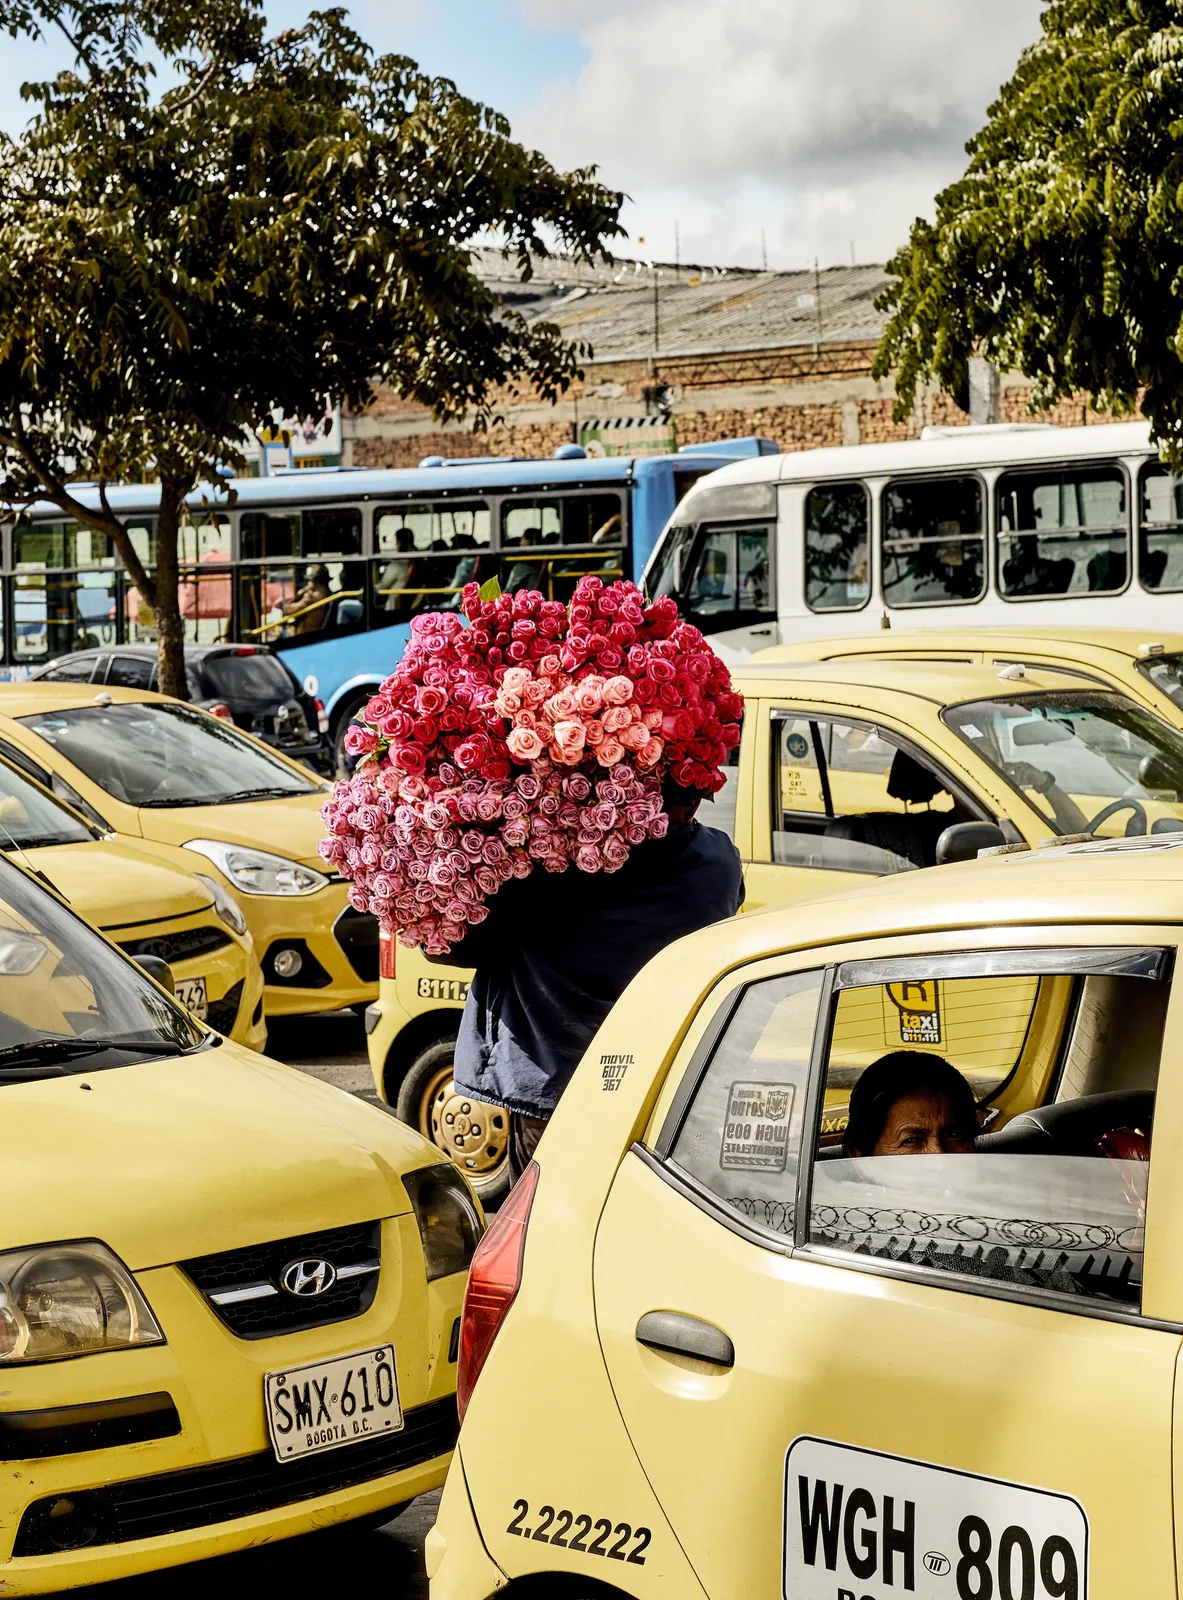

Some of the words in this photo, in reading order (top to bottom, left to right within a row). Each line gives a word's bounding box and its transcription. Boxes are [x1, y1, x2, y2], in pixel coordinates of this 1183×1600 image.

[902, 1012, 938, 1030] taxi
[903, 1032, 939, 1042] 8111.111
[602, 1065, 628, 1078] 6077
[602, 1079, 622, 1091] 367
[274, 1376, 332, 1434] SMX
[341, 1362, 394, 1417] 610
[306, 1424, 347, 1447] BOGOTA
[353, 1418, 373, 1435] D.C.
[506, 1499, 652, 1566] 2.222222
[798, 1475, 916, 1592] WGH
[956, 1515, 1078, 1600] 809
